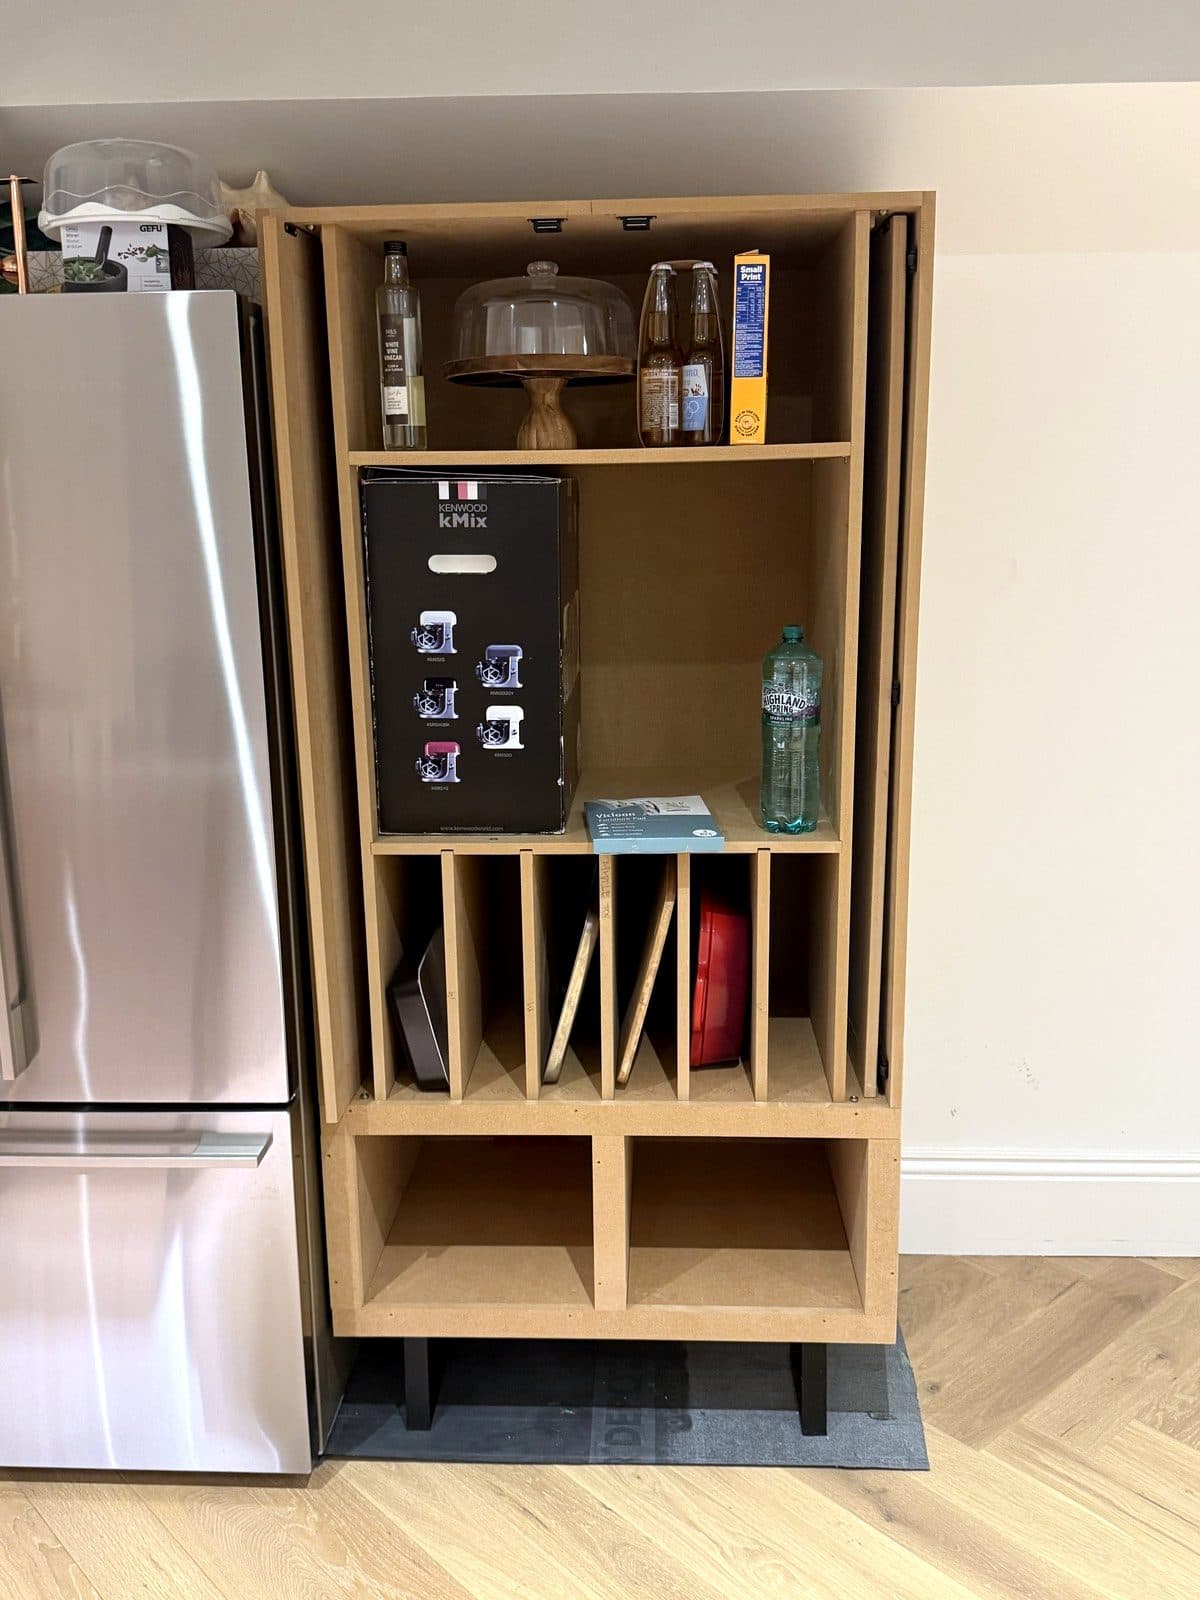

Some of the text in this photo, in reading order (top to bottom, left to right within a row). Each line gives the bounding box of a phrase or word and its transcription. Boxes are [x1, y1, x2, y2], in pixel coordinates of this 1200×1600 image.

[140, 224, 162, 232] GEFU
[740, 265, 763, 273] Small
[741, 273, 761, 281] Print
[438, 503, 488, 512] KENWOOD
[439, 512, 488, 528] kMix
[763, 694, 806, 710] HIGHLAND
[769, 704, 794, 714] SPRING
